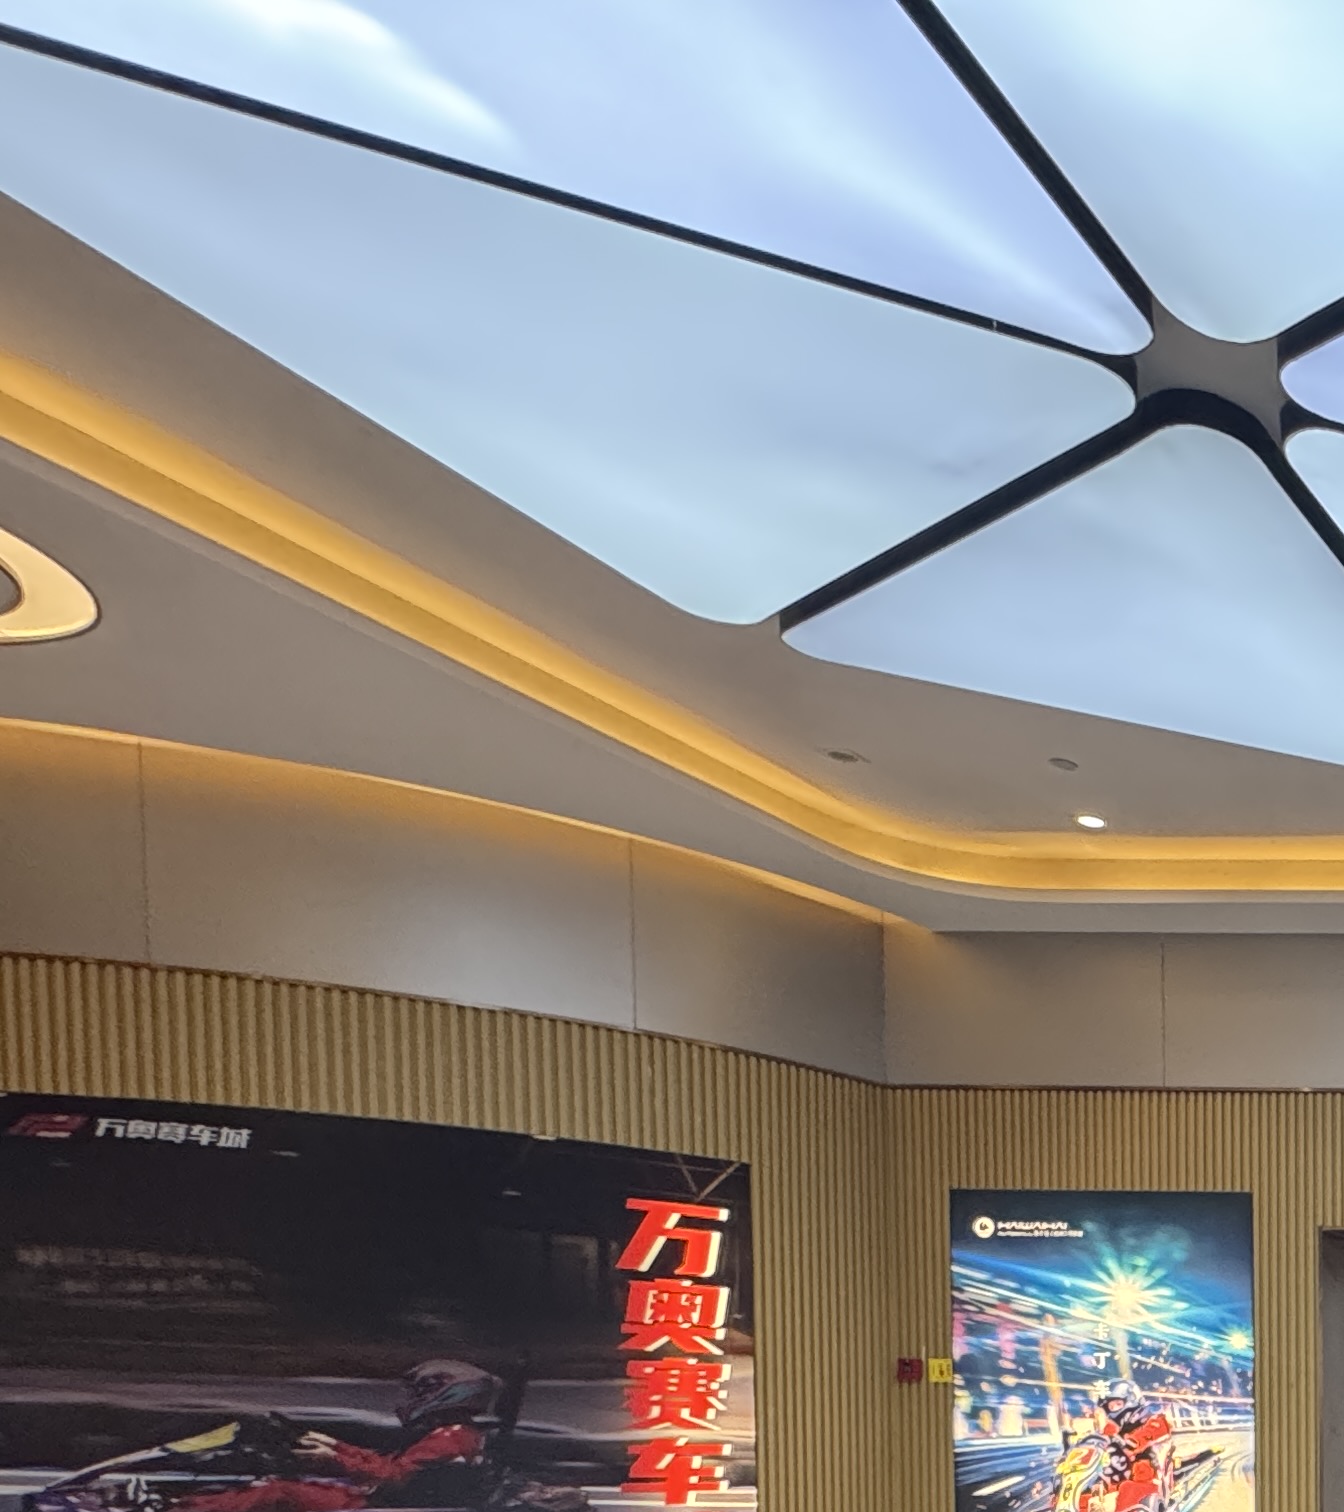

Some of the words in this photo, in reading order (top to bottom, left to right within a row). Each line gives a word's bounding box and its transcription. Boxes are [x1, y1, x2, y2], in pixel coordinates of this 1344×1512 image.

[94, 1117, 253, 1149] 万奥赛车城
